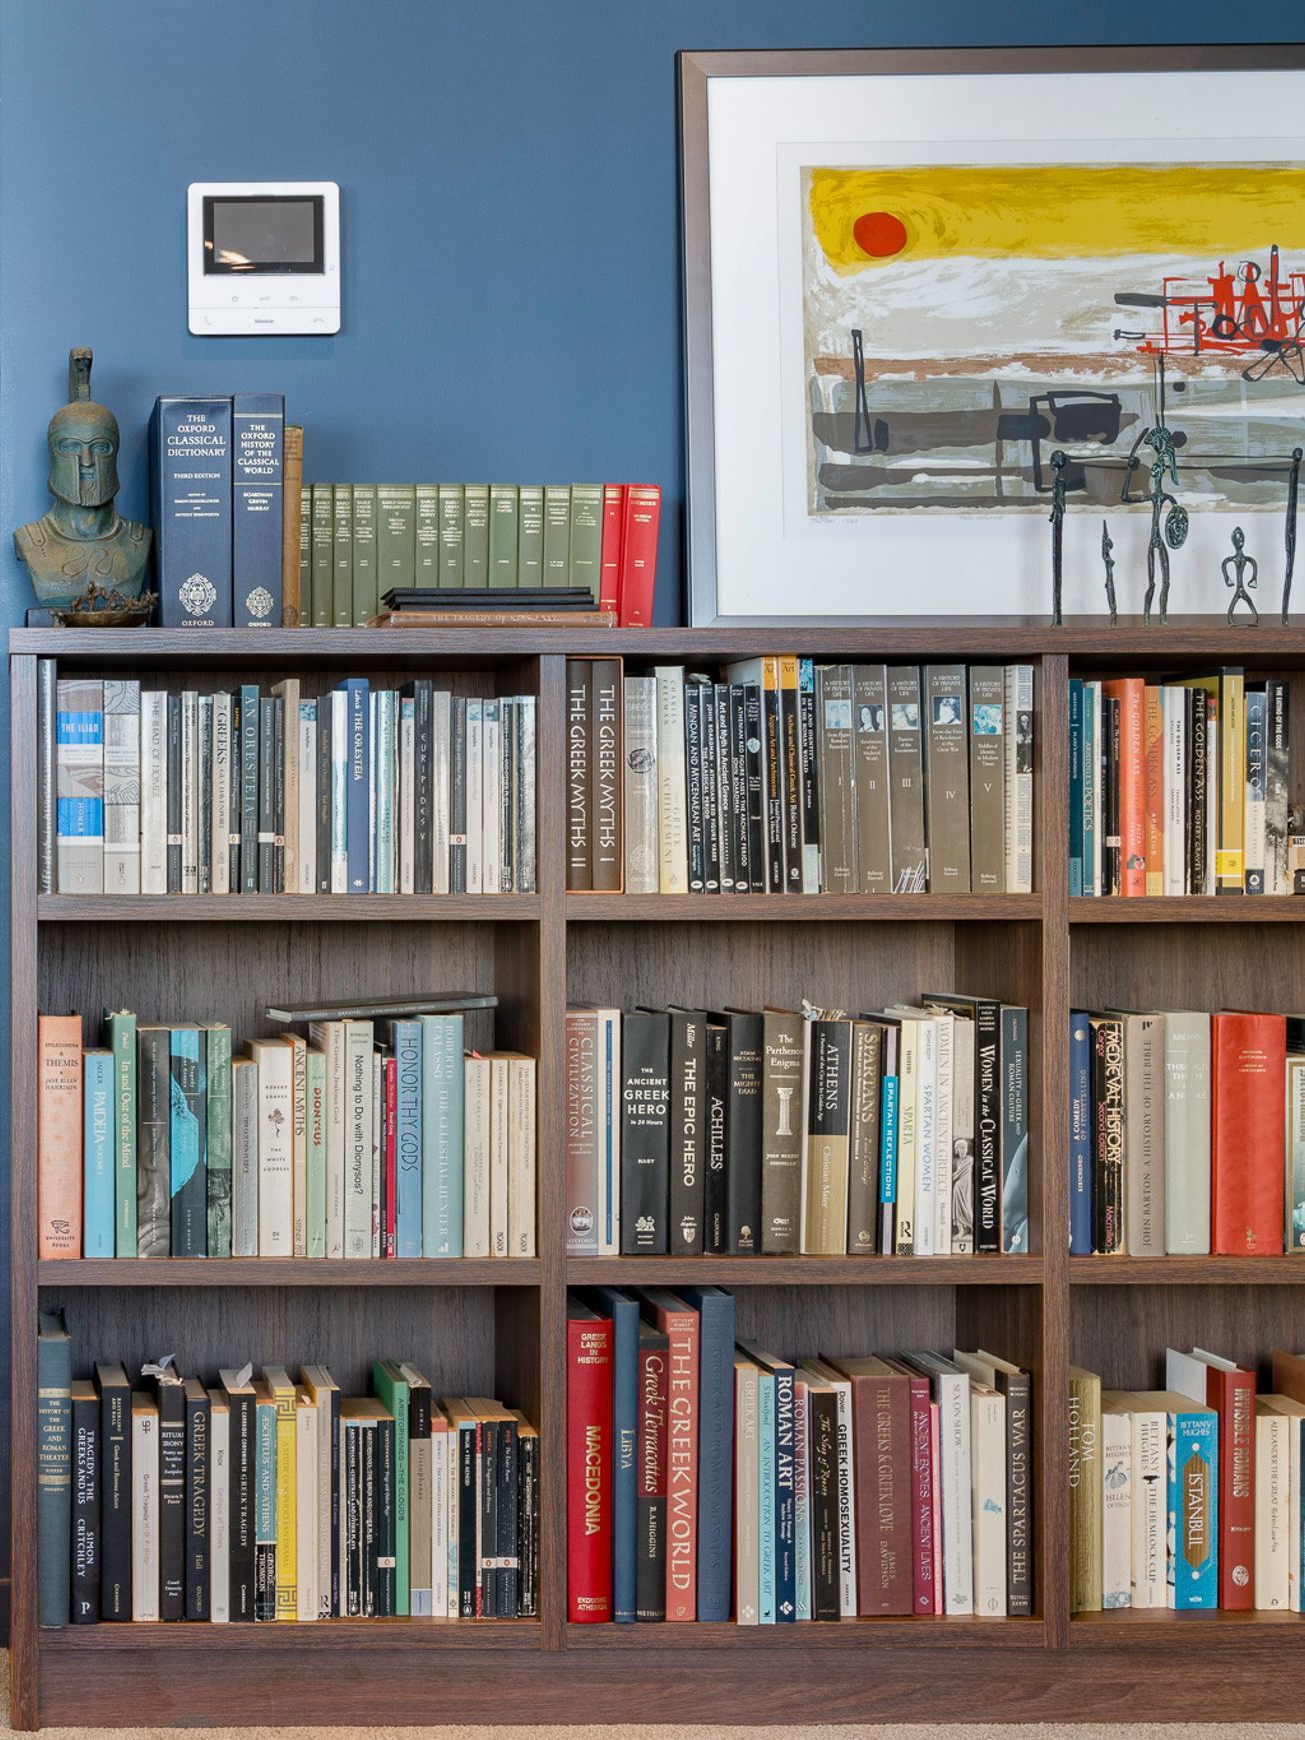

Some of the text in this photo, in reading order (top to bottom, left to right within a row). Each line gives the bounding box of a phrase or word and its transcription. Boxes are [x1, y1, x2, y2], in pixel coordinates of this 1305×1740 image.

[168, 436, 226, 445] CLASSICAL
[168, 448, 226, 456] DICTIONARY
[62, 724, 98, 732] THE ILIAD
[600, 685, 614, 721] THE
[689, 704, 698, 743] MINOAN
[217, 713, 227, 764] GREEKS
[246, 696, 255, 813] AN ORESTEIA
[354, 712, 363, 780] THE ORESTEIA
[599, 726, 615, 779] GREEK
[690, 746, 699, 765] AND
[720, 729, 728, 747] Myth
[721, 757, 729, 783] Ancient
[1195, 695, 1204, 801] THE GOLDEN ASS
[1250, 705, 1262, 788] CICERO
[570, 685, 585, 867] THE GREEK MYTHS II
[690, 770, 700, 824] MYCENAEAN
[600, 784, 615, 847] MYTHS
[433, 1026, 443, 1078] CALASSO
[445, 1025, 454, 1078] ROBERTO
[827, 1045, 838, 1110] ATHENS
[863, 1033, 877, 1122] SPARTANS
[94, 1092, 106, 1143] PAIDEIA
[122, 1061, 131, 1168] In and Out of the Mind
[296, 1047, 304, 1136] ANCIENT MYTHS
[401, 1039, 418, 1172] HONOR THY GODS
[569, 1038, 578, 1136] CIVILIZATION
[581, 1038, 592, 1137] CLASSICAL
[624, 1090, 669, 1100] GREEK
[627, 1105, 666, 1114] HERO
[684, 1023, 695, 1186] Miller THE EPIC HERO
[982, 1094, 989, 1102] in
[982, 1104, 990, 1116] the
[1106, 1030, 1121, 1164] MEDIEVAL HISTORY
[353, 1055, 364, 1194] Nothing to Do with Dionysos?
[711, 1097, 723, 1169] ACHILLES
[923, 1085, 932, 1192] SPARTAN WOMEN
[439, 1089, 448, 1236] THE CELESTIAL HUNTER
[821, 1146, 832, 1208] Christian Meier
[885, 1130, 893, 1197] REFLECTIONS
[644, 1356, 662, 1405] Greek
[78, 1428, 86, 1504] GREEKS AND US
[620, 1429, 635, 1469] LIBYA
[644, 1409, 663, 1492] Terracottas
[670, 1338, 691, 1589] THE GREEK WORLD
[778, 1376, 792, 1490] ROMAN ART
[876, 1388, 893, 1531] THE GREEKS & GREEK LOVE
[1069, 1397, 1079, 1487] HOLLAND
[1083, 1421, 1095, 1461] TOM
[1233, 1389, 1250, 1498] INVISIBLE ROMANS
[193, 1412, 205, 1569] GREEK TRAGEDY Hall
[262, 1469, 270, 1490] AND
[586, 1426, 600, 1535] MACEDONIA
[838, 1424, 850, 1573] GREEK HOMOSEXUALITY
[1012, 1409, 1026, 1583] THE SPARTACUS WAR
[1189, 1473, 1203, 1549] ISTANBUL
[77, 1519, 85, 1577] CRITCHLEY
[262, 1496, 270, 1533] ATHENS
[1149, 1510, 1157, 1559] HEMLOCK
[888, 1551, 896, 1579] JAMES
